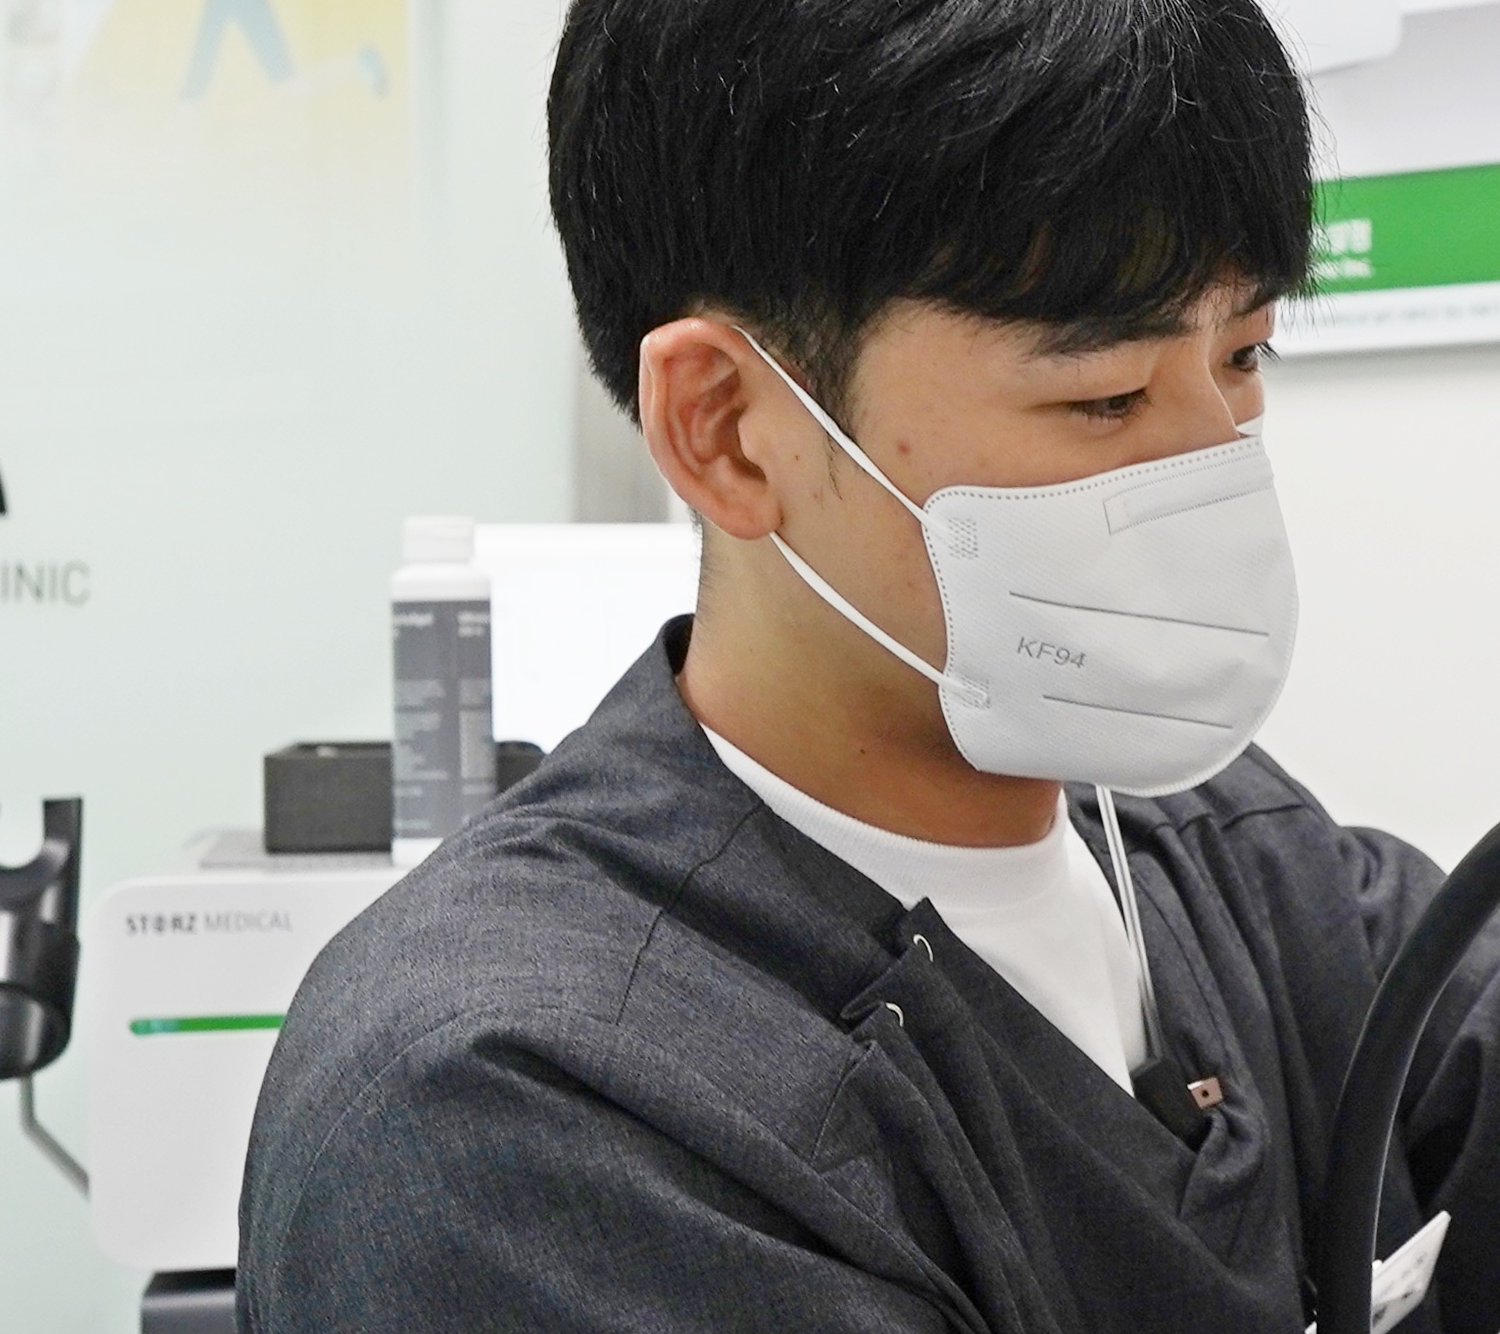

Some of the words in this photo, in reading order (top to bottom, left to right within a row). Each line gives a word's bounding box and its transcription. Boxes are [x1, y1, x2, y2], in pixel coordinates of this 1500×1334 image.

[1016, 635, 1087, 670] KF94
[125, 912, 198, 937] STORZ
[203, 909, 293, 934] MEDICAL
